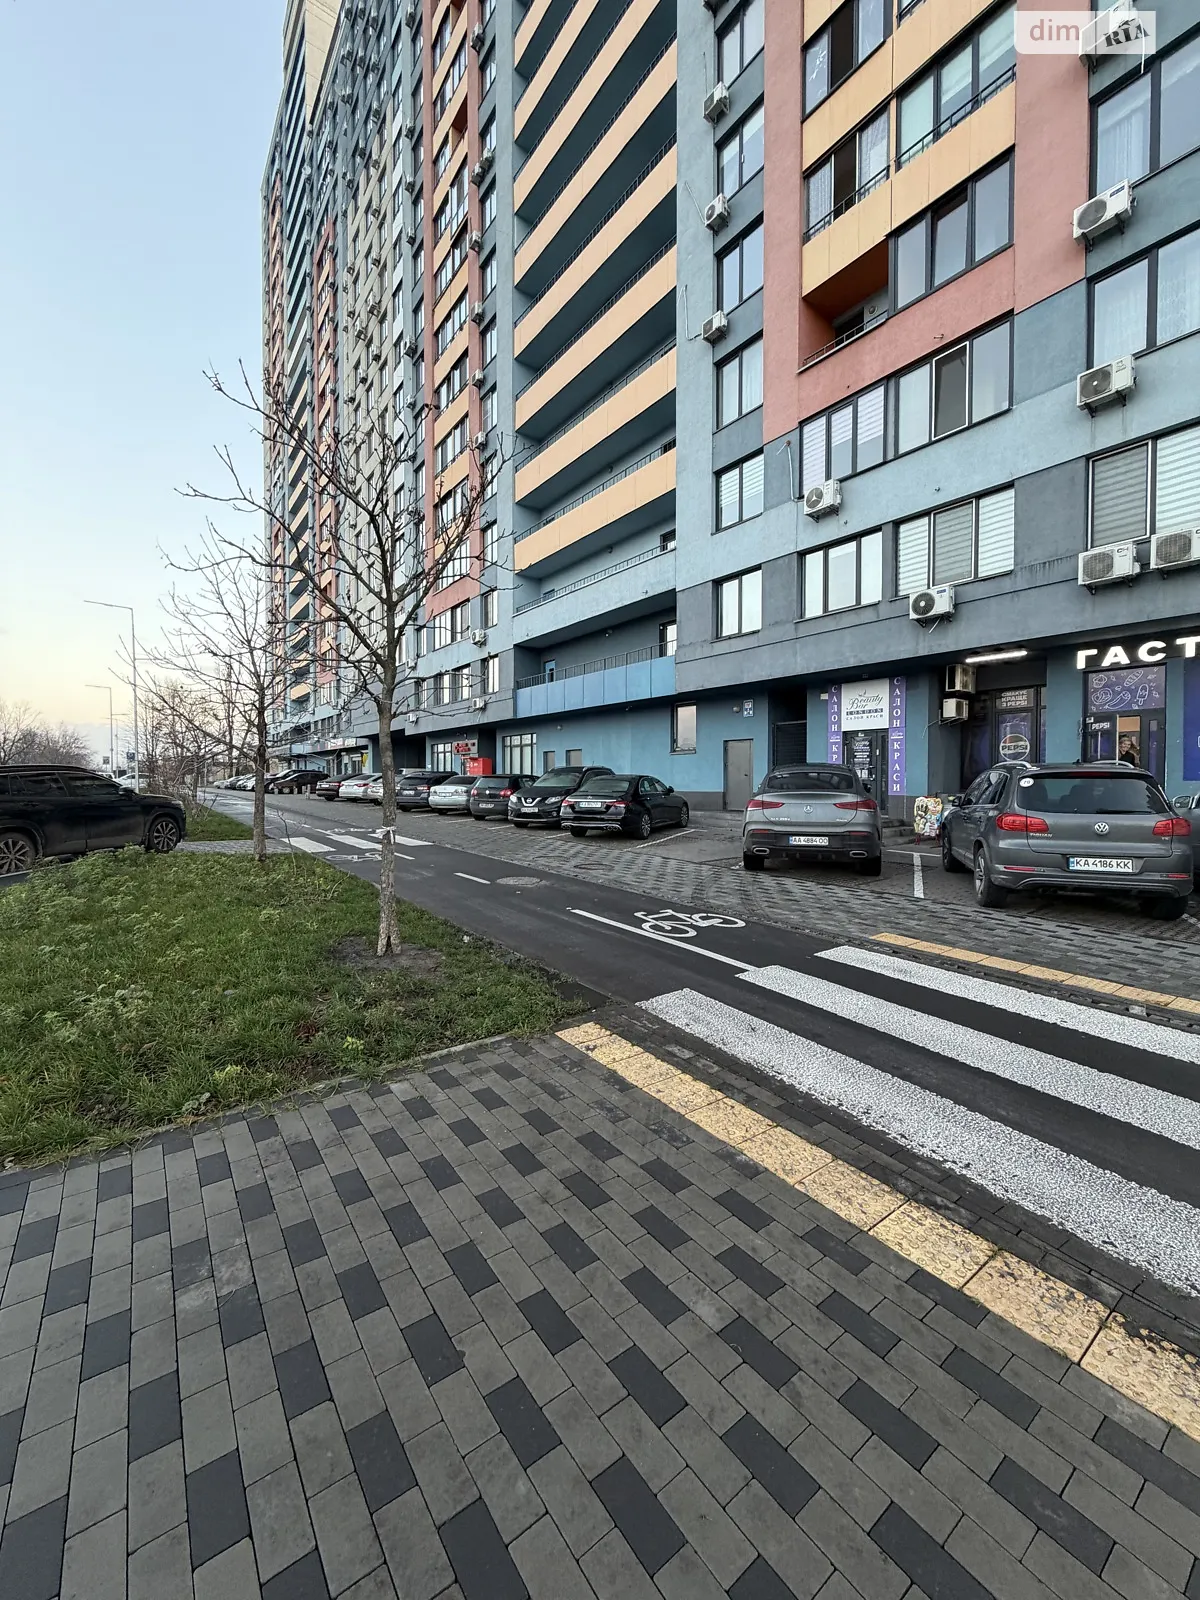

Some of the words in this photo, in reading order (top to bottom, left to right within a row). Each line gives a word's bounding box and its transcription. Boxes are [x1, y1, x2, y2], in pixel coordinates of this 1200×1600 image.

[1076, 636, 1200, 670] ГАСТ
[893, 677, 901, 727] САЛОН
[1092, 722, 1110, 730] PEPSI
[892, 742, 901, 792] КРАСИ
[1075, 858, 1090, 867] KA
[1091, 859, 1114, 868] 4186
[1116, 860, 1131, 870] KK
